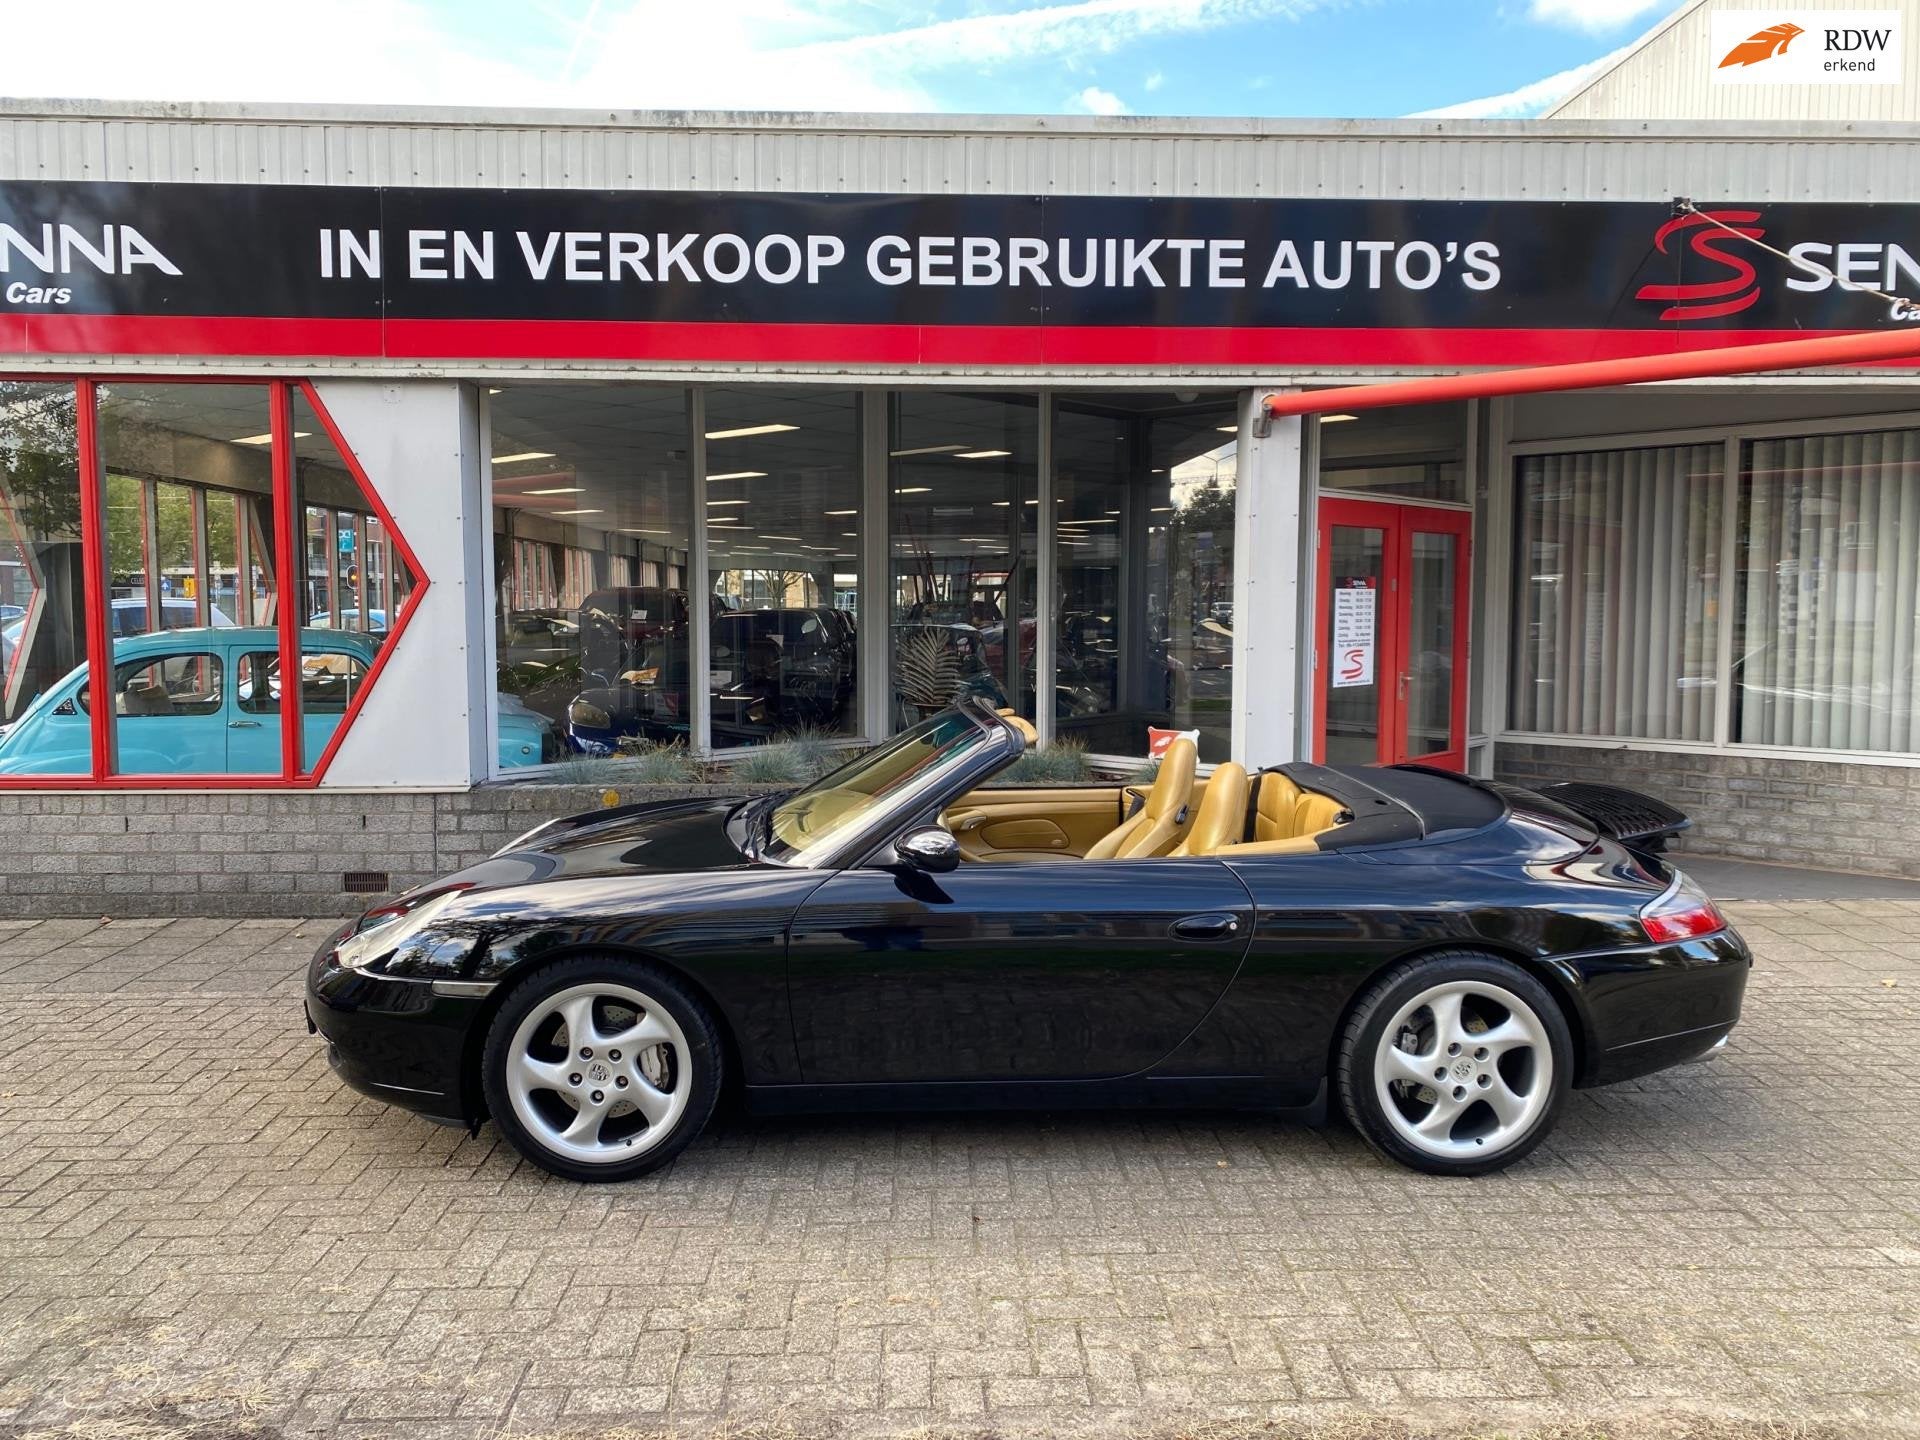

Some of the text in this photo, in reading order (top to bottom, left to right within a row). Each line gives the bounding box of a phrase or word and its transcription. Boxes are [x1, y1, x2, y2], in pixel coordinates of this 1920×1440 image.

[0, 222, 183, 276] NNA
[319, 229, 1501, 291] IN EN VERKOOP GEBRUIKTE AUTO’S
[5, 281, 72, 305] Cars
